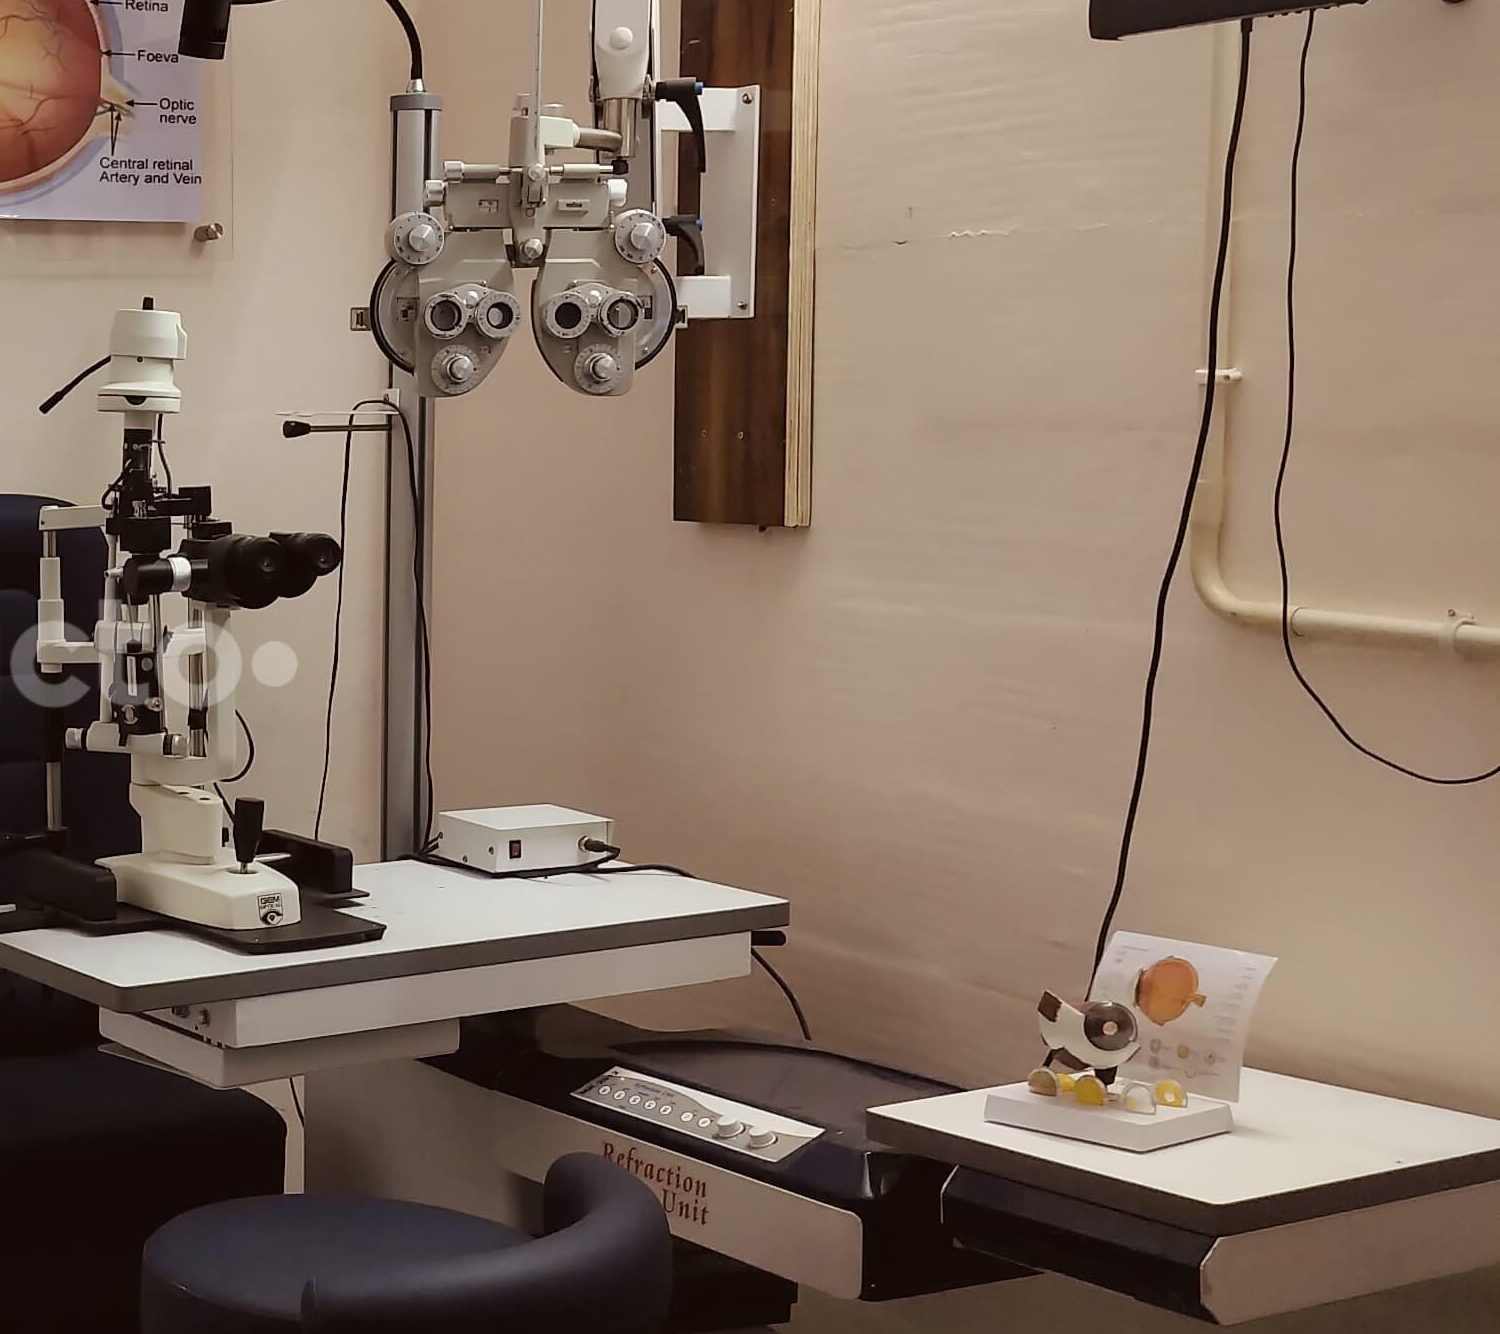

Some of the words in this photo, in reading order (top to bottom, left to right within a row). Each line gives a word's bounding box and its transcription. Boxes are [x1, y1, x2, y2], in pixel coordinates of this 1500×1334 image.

[137, 49, 179, 64] Foeva
[159, 98, 194, 113] Optic
[159, 114, 196, 124] nerve
[100, 158, 149, 171] Central
[153, 158, 193, 171] retinal
[100, 172, 138, 186] Artery
[142, 173, 168, 185] and
[172, 173, 202, 185] Vein
[603, 1142, 706, 1198] Refraction
[662, 1189, 708, 1225] Unit
